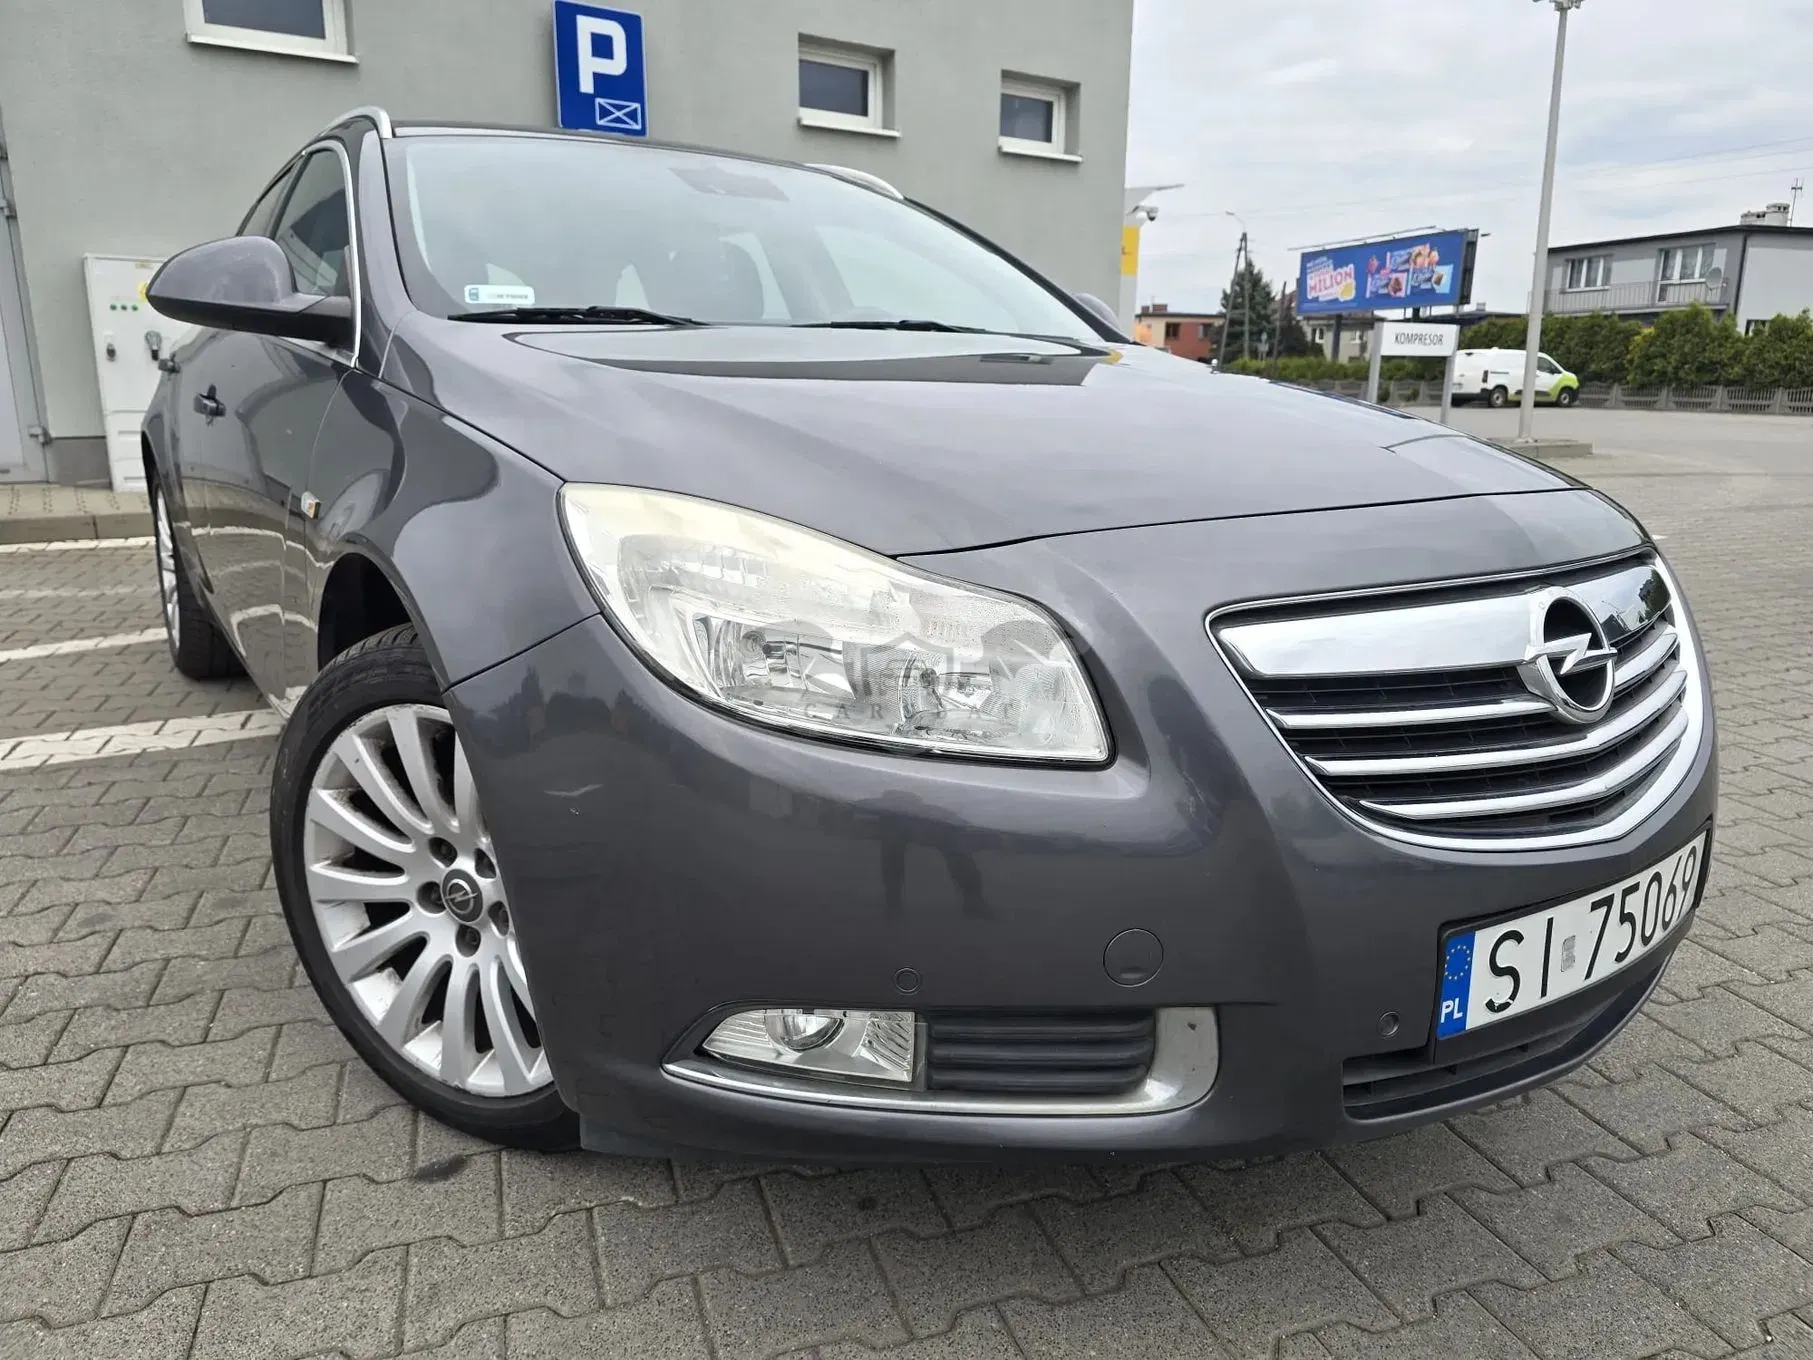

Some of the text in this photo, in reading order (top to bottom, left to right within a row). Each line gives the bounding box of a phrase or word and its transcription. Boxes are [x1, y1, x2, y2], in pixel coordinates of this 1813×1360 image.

[576, 14, 627, 94] P
[1394, 332, 1444, 346] KOMPRESOR
[1485, 845, 1698, 1014] SI 75069
[1440, 997, 1463, 1024] PL
